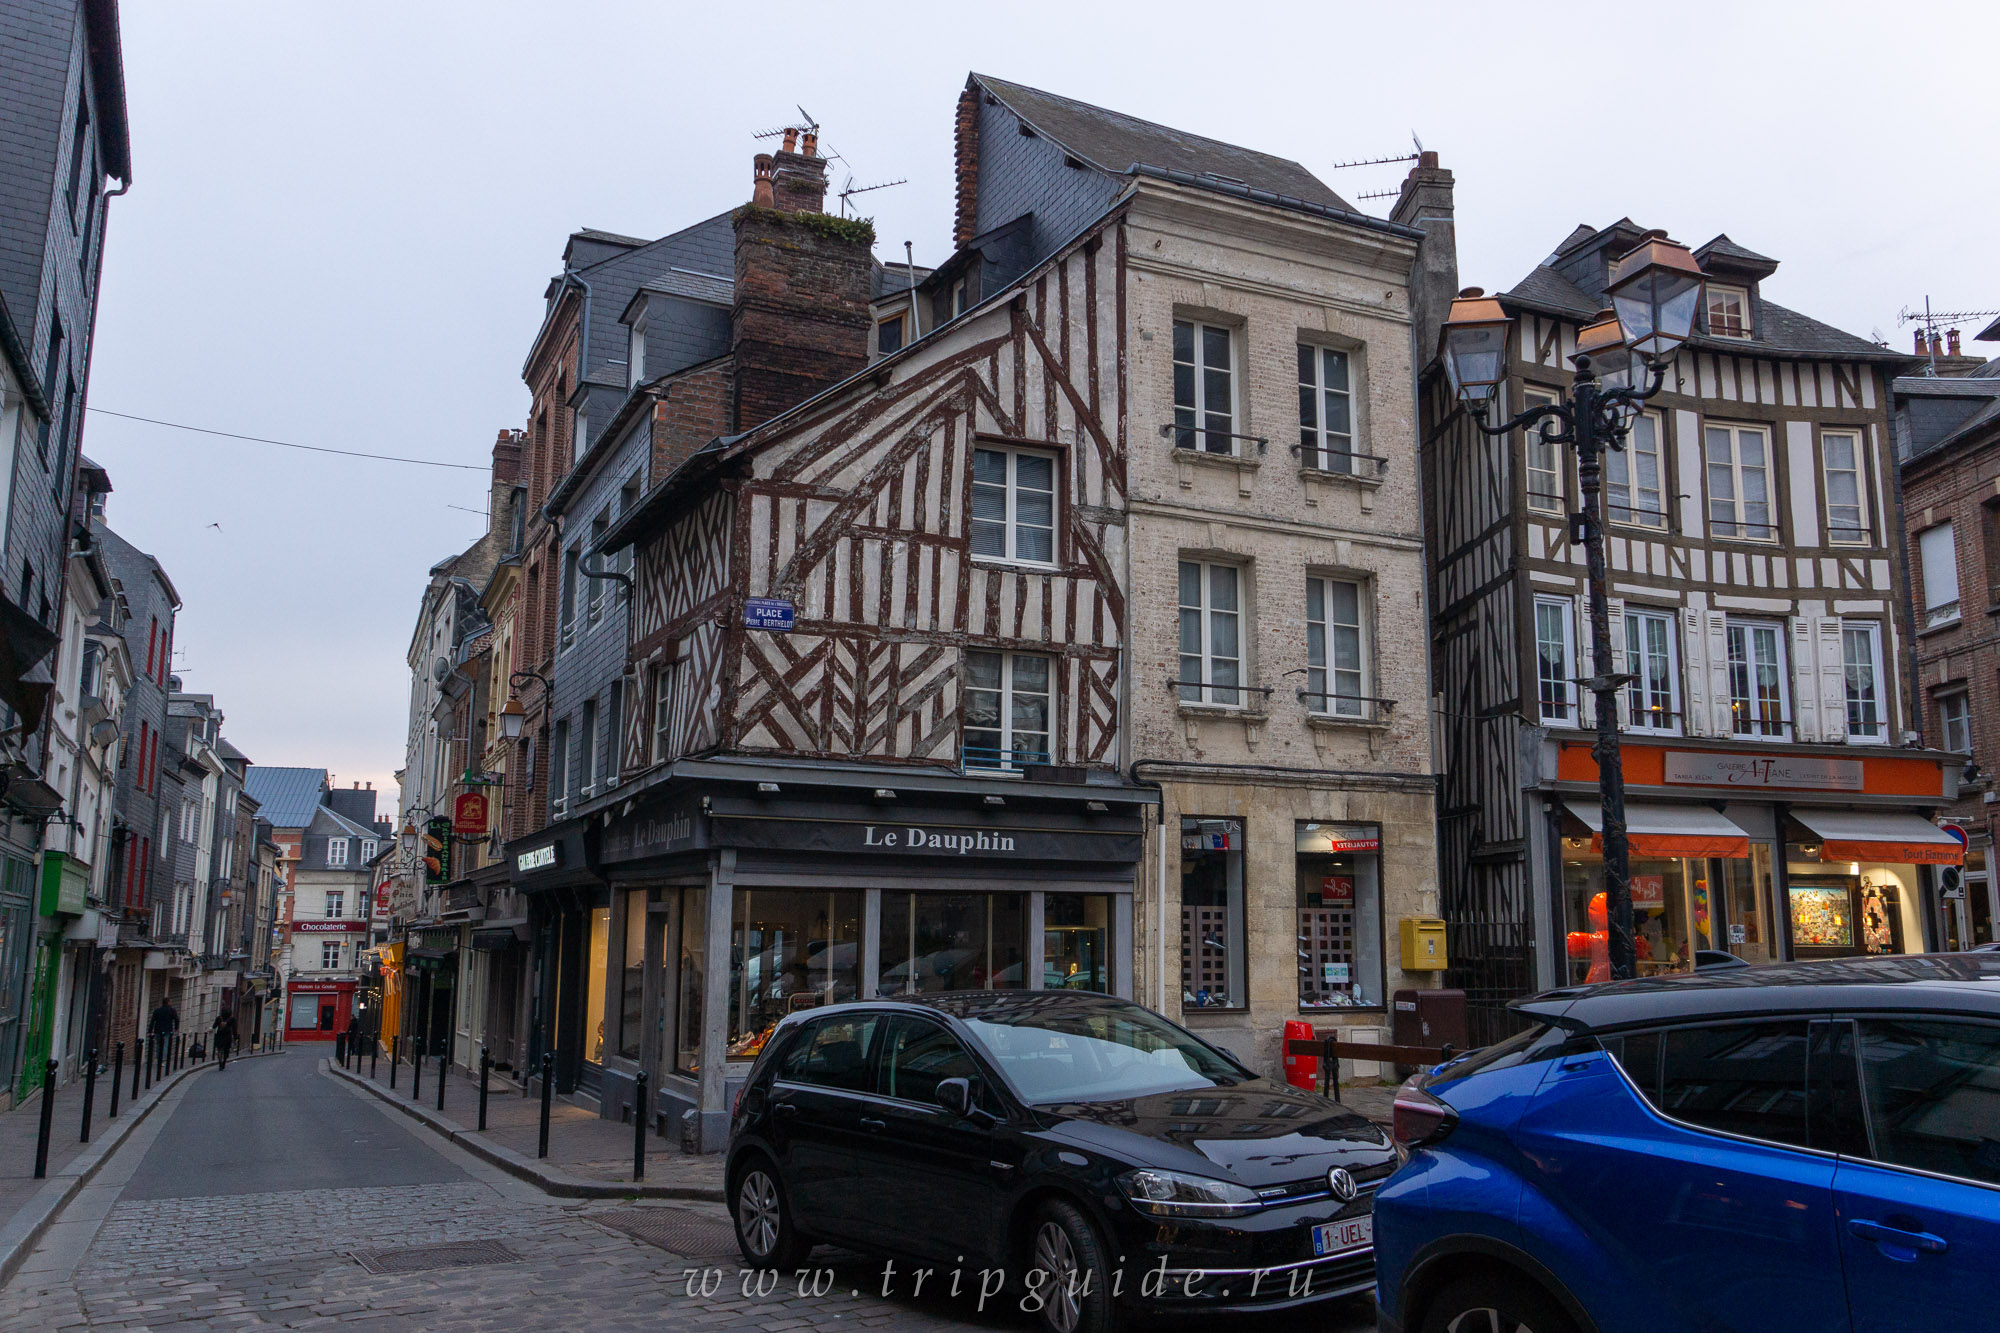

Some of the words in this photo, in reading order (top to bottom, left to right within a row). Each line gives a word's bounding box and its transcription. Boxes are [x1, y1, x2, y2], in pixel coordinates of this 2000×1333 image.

[756, 608, 783, 618] PLACE
[763, 618, 793, 629] BERTHELOT
[1717, 762, 1745, 771] GALERIE
[634, 823, 646, 848] Le
[647, 811, 691, 850] Dauphin
[863, 826, 897, 847] Le
[905, 827, 1015, 855] Dauphin
[1903, 848, 1923, 860] Tout
[1924, 849, 1959, 861] Flamme
[301, 923, 347, 931] Chocolaterie
